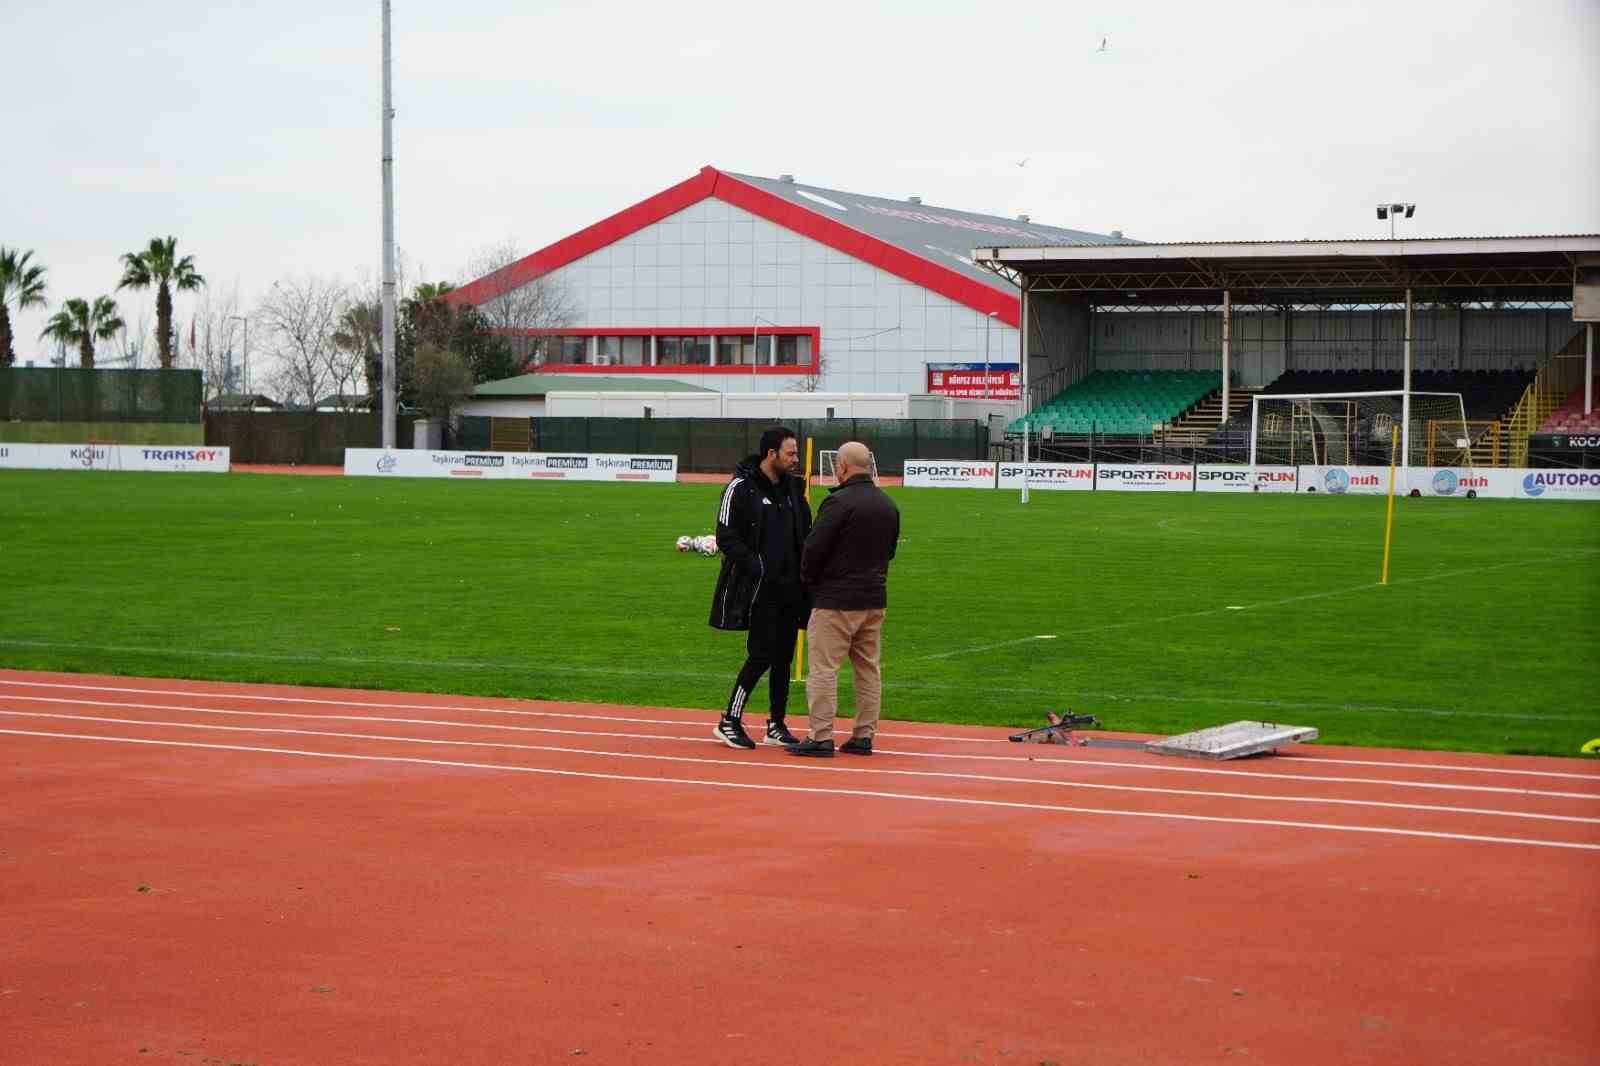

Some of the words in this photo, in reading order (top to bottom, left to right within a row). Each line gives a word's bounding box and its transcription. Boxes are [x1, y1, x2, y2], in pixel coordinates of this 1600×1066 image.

[142, 450, 216, 461] TRANSAY
[906, 466, 994, 477] SPORTRUN
[1001, 468, 1092, 479] SPORTRUN
[1099, 470, 1192, 481] SPORTRUN
[1351, 474, 1379, 485] nuh
[1459, 476, 1488, 487] nuh
